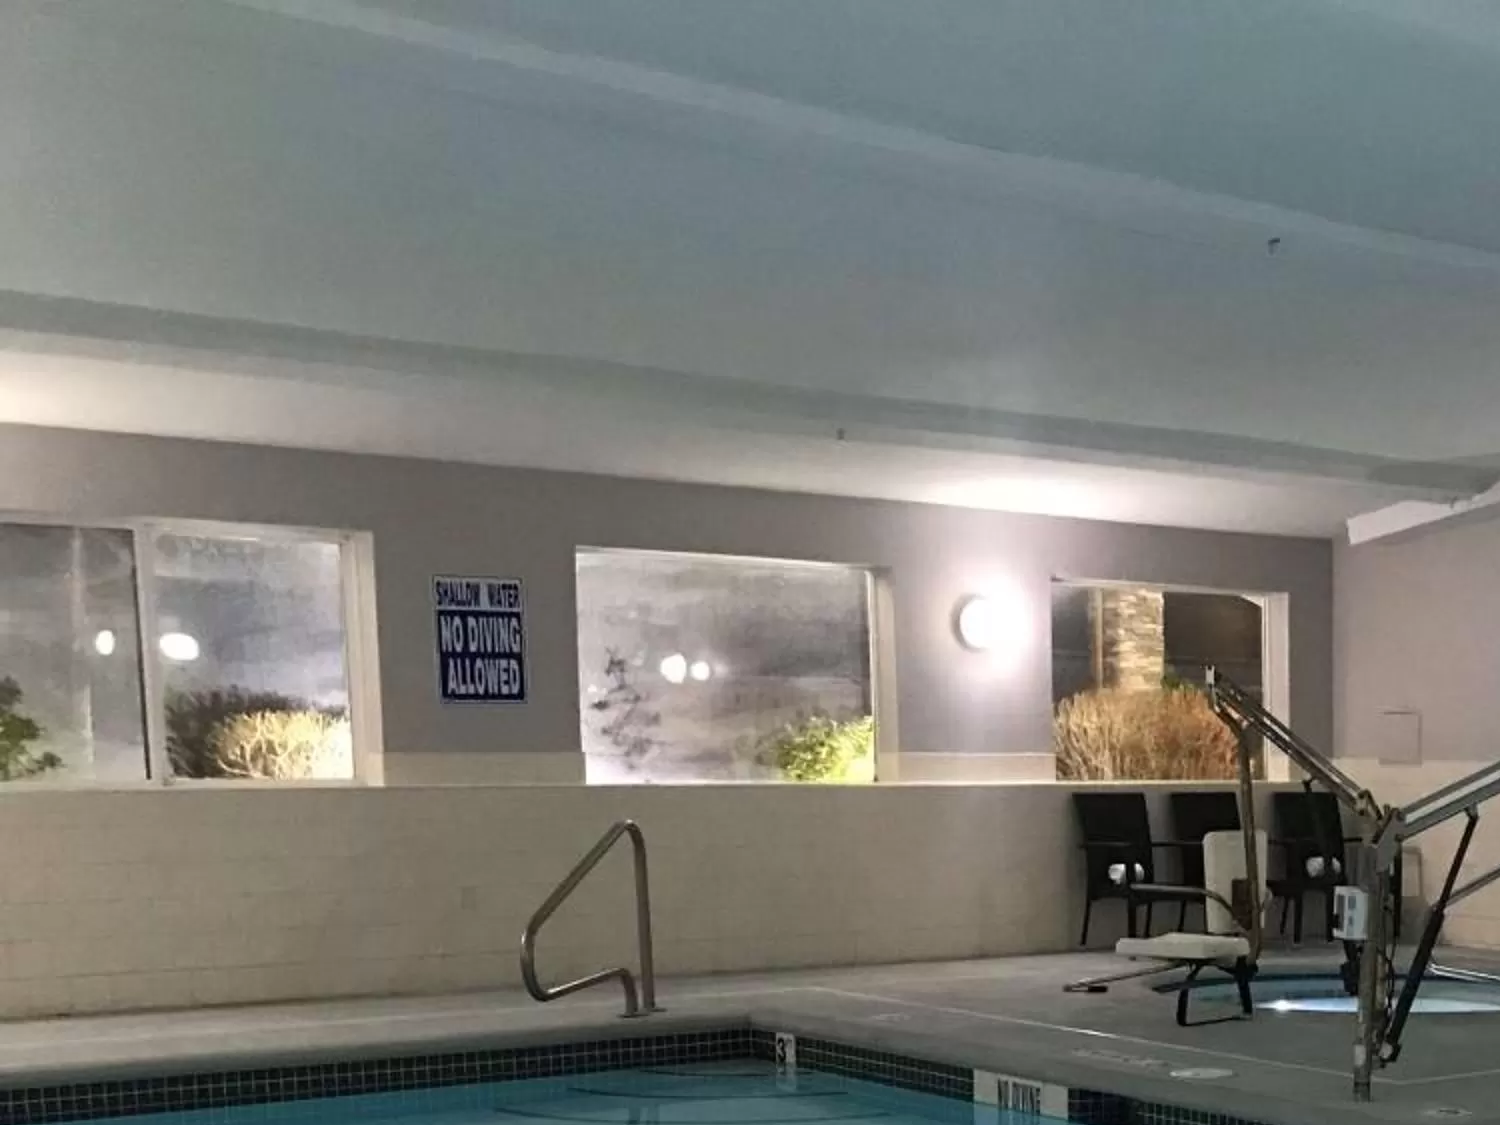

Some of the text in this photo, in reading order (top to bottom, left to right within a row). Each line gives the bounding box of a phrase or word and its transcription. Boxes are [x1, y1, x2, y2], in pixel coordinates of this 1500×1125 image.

[440, 615, 521, 653] NO DIVING
[448, 657, 520, 695] ALLOWED
